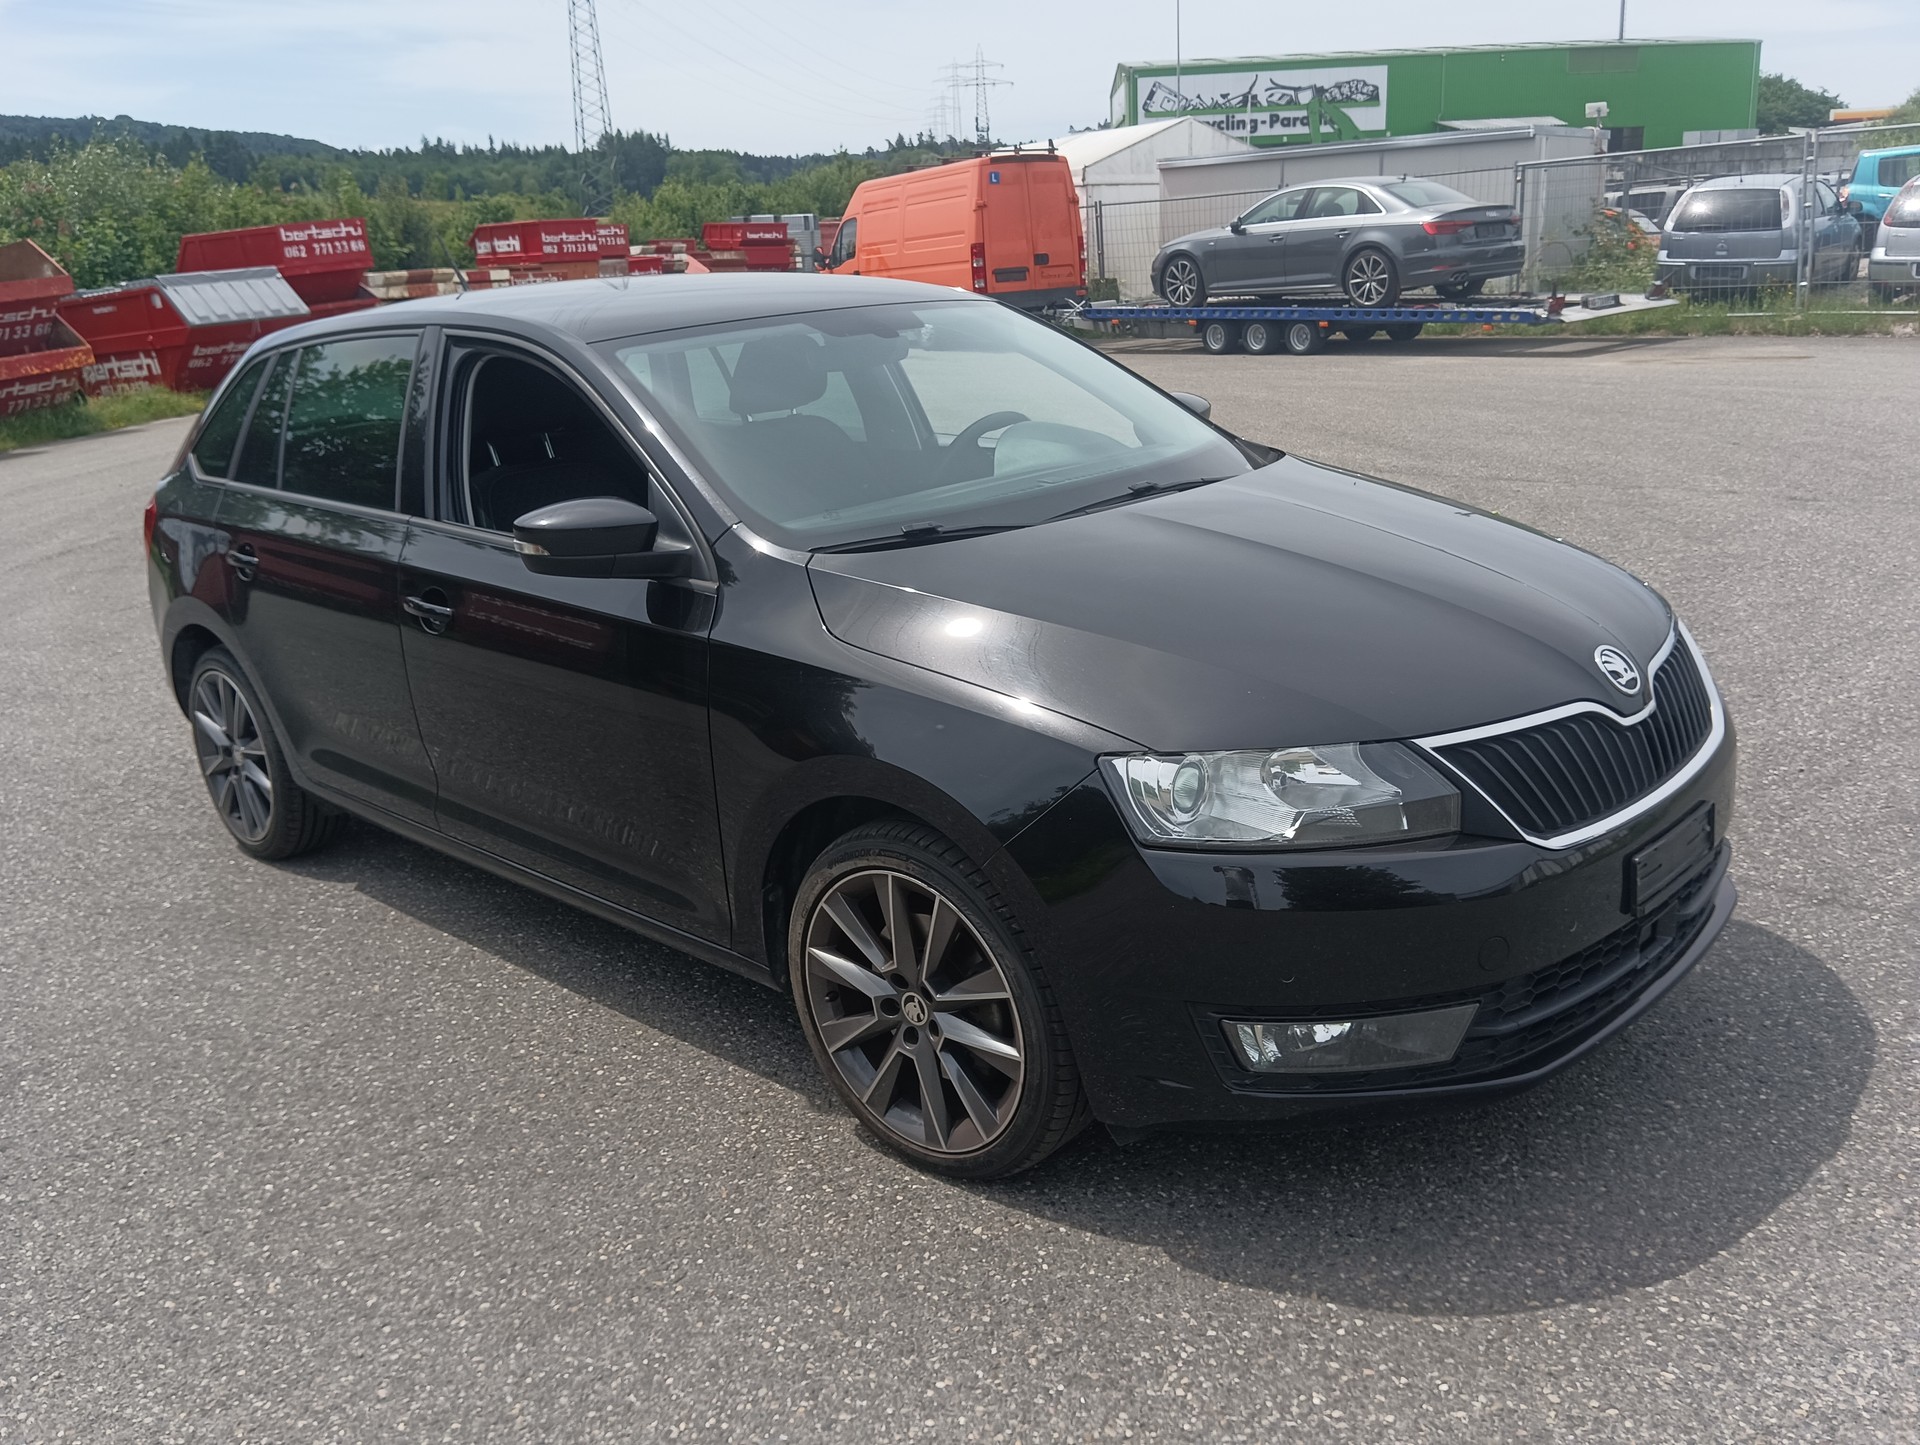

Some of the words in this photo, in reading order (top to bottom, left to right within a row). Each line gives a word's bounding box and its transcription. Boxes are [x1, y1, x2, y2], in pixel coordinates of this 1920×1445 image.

[280, 220, 363, 242] bertschi
[541, 229, 597, 243] bertschi
[284, 244, 308, 258] 062
[312, 242, 334, 256] 771
[334, 240, 350, 254] 33
[0, 303, 57, 323] schi
[13, 325, 31, 339] 33
[0, 371, 78, 399] rtschi
[8, 397, 31, 414] 771
